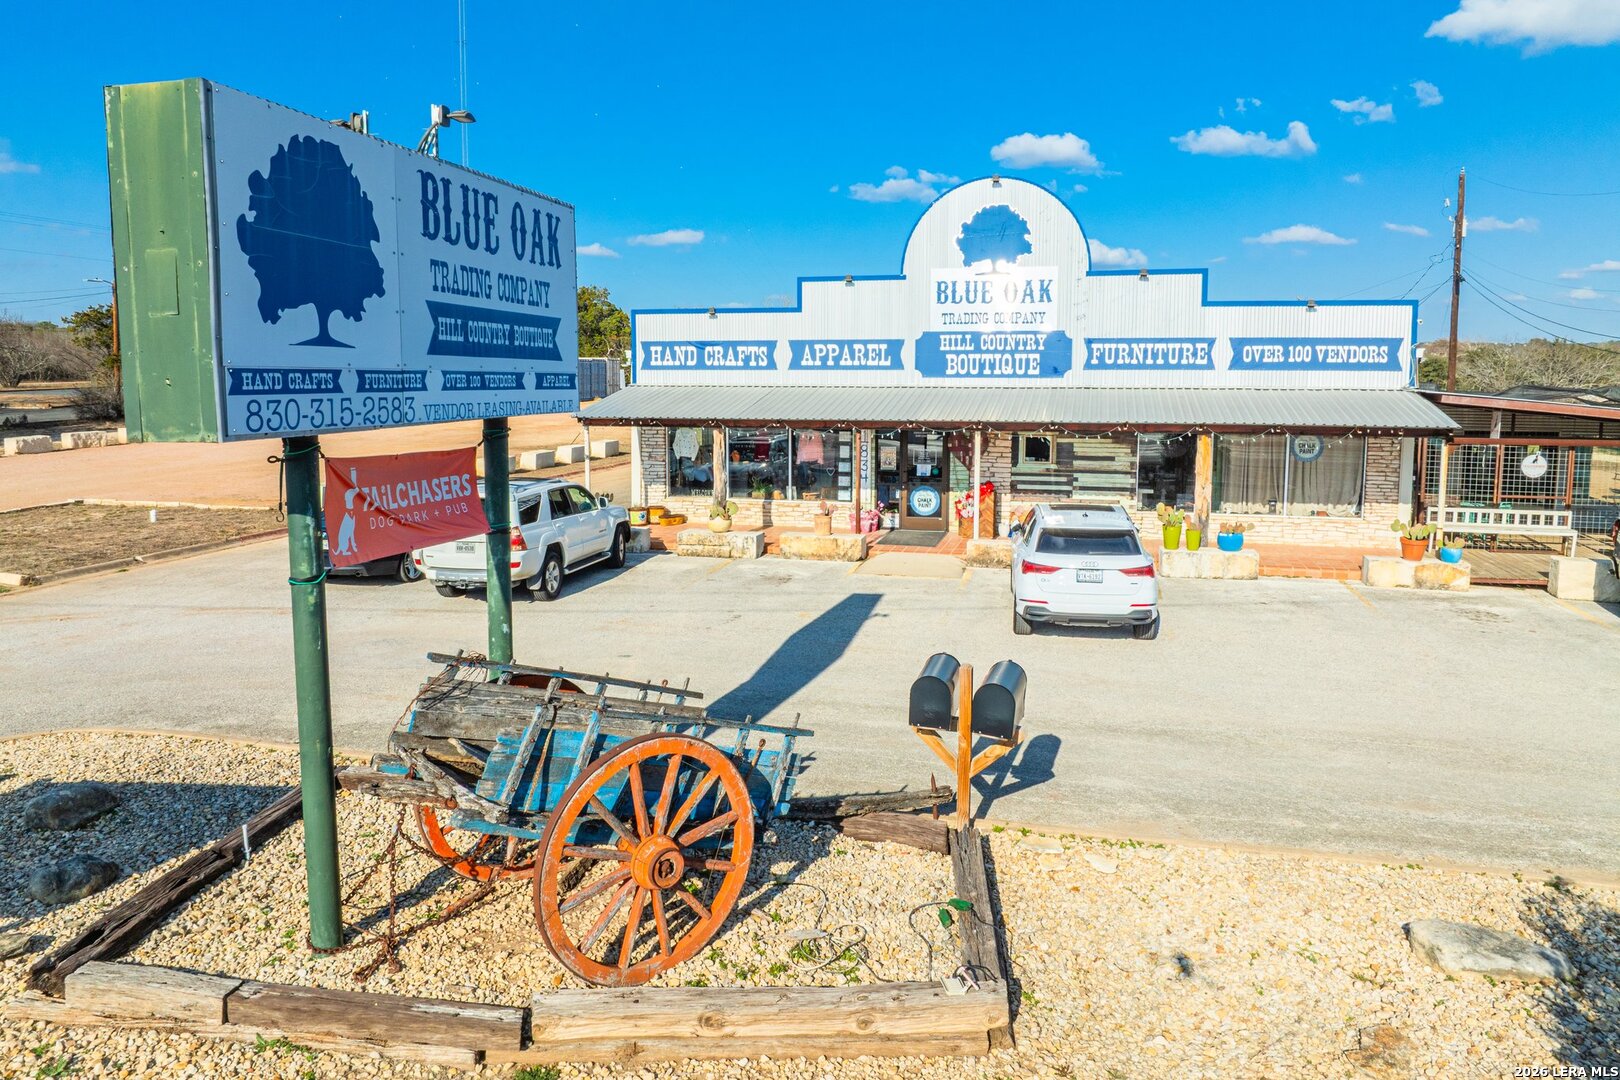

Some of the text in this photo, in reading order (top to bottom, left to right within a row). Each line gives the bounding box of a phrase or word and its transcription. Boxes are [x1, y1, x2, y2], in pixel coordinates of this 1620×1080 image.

[417, 169, 562, 269] BLUE OAK
[430, 259, 550, 308] TRADING COMPANY
[936, 279, 1053, 304] BLUE OAK
[942, 312, 989, 325] TRADING
[438, 317, 553, 348] HILL COUNTRY BOUTIQUE
[939, 334, 1047, 351] HILL COUNTRY
[650, 346, 768, 367] HAND CRAFTS
[800, 343, 892, 367] APPAREL
[946, 353, 1040, 375] BOUTIQUE
[1090, 342, 1208, 366] FURNITURE
[1242, 345, 1389, 364] OVER 100 VENDORS
[241, 372, 334, 390] HAND CRAFTS
[364, 373, 422, 389] FURNITURE
[445, 373, 517, 388] OVER 100 VENDORS
[542, 375, 571, 387] APPAREL
[246, 396, 416, 433] 830-315-2583
[423, 402, 475, 421] VENDOR
[370, 516, 394, 529] DOG
[399, 510, 429, 523] PARK
[445, 502, 469, 517] PUB
